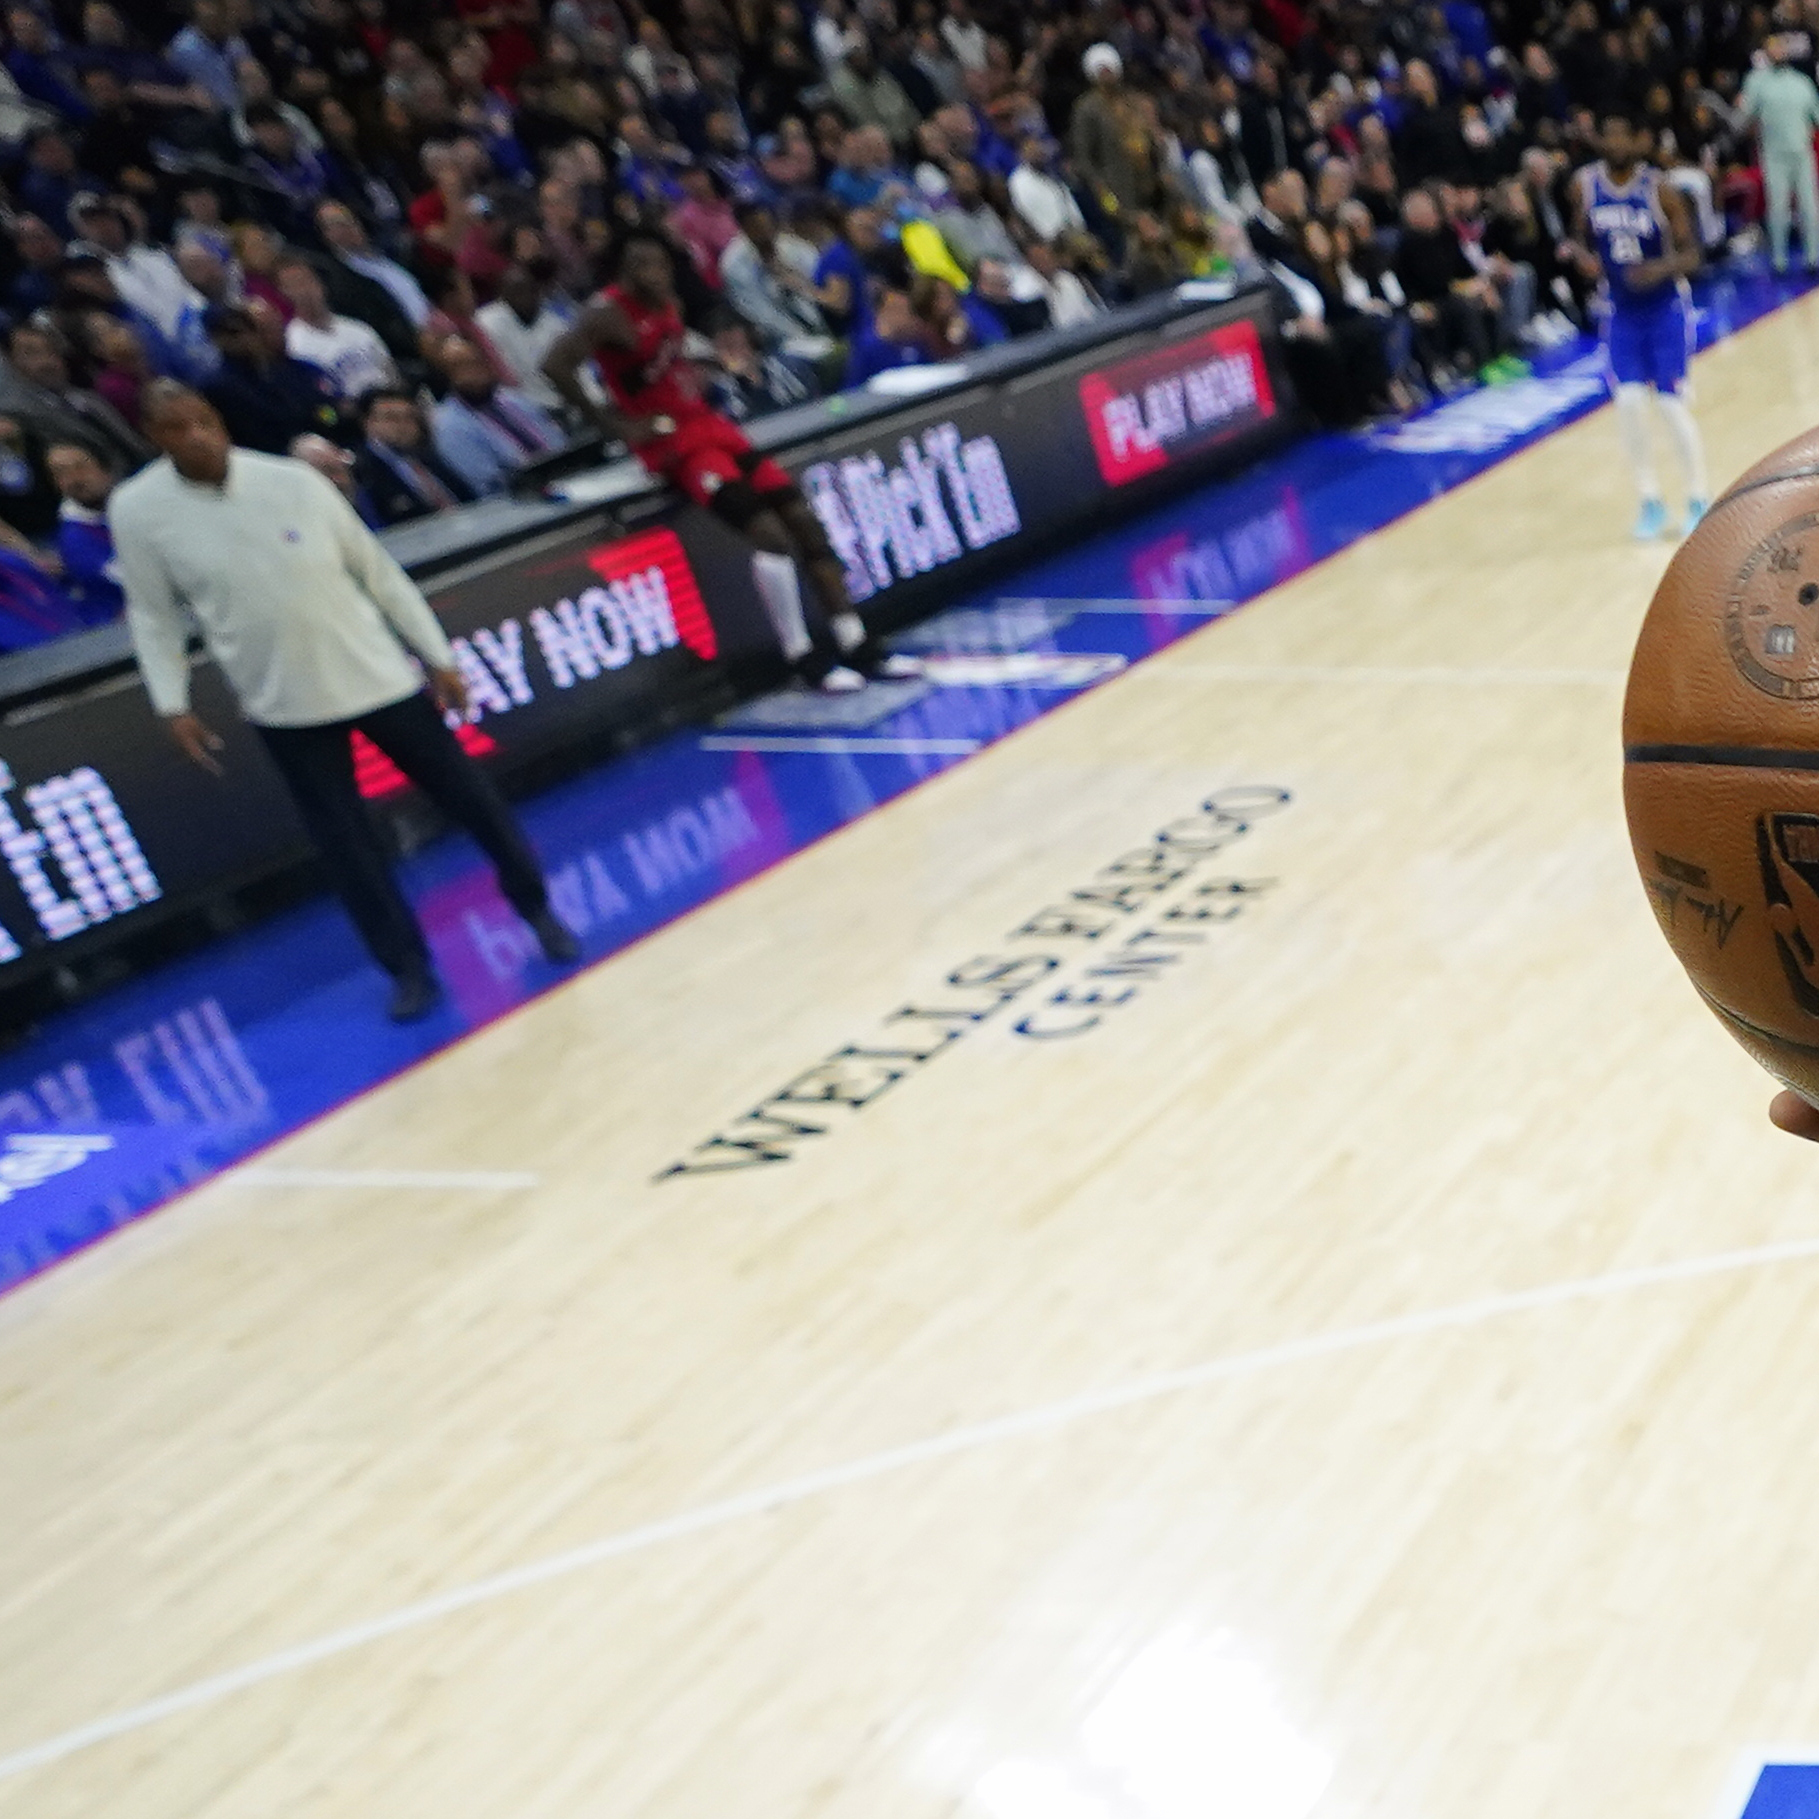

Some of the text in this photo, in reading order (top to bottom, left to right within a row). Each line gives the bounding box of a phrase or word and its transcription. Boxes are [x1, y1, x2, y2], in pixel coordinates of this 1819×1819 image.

[1102, 351, 1258, 464] PLAY NOW
[443, 565, 680, 730] AY NOW
[650, 783, 1296, 1185] WELLS FARGO
[1011, 874, 1280, 1042] CENTER
